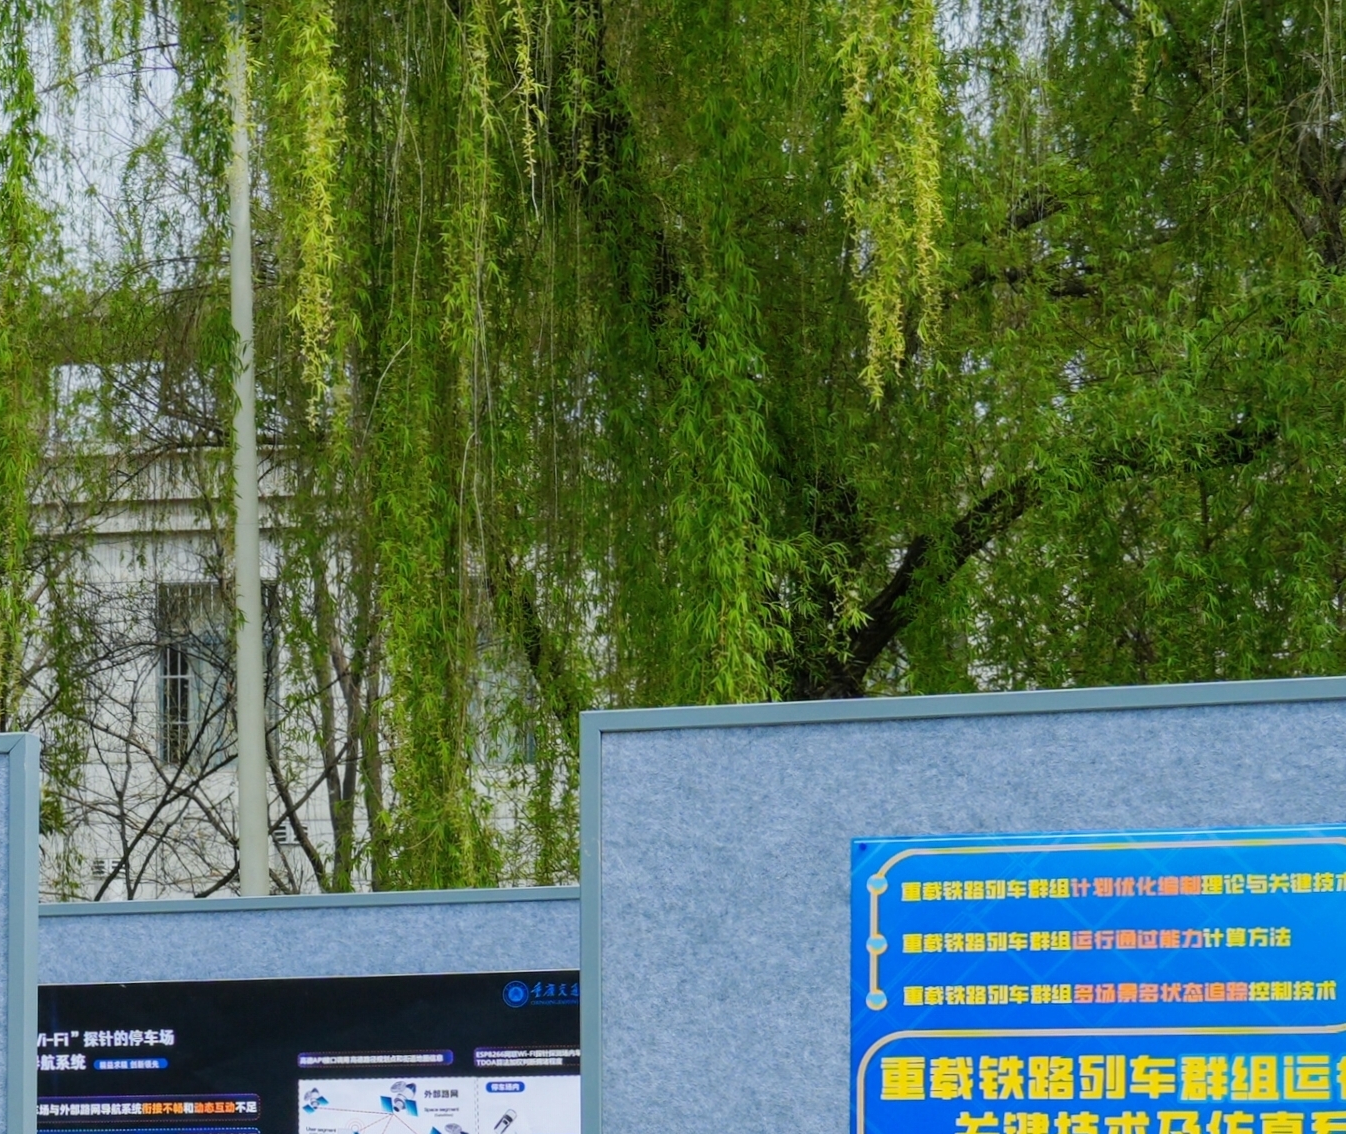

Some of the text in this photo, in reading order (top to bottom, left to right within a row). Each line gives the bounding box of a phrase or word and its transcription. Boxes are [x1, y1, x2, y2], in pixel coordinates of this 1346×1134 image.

[902, 927, 1291, 954] 重载铁路列车群组运行通过能力计算方法
[903, 980, 1337, 1006] 重载铁路列车群组多场景多状态追踪控制技术
[37, 1053, 86, 1070] 航系统
[880, 1054, 1346, 1101] 重载铁路列车群组运
[424, 1089, 459, 1098] 外部路网
[36, 1101, 258, 1116] 场与外部路网导航系统衔接不畅和动态互动不足
